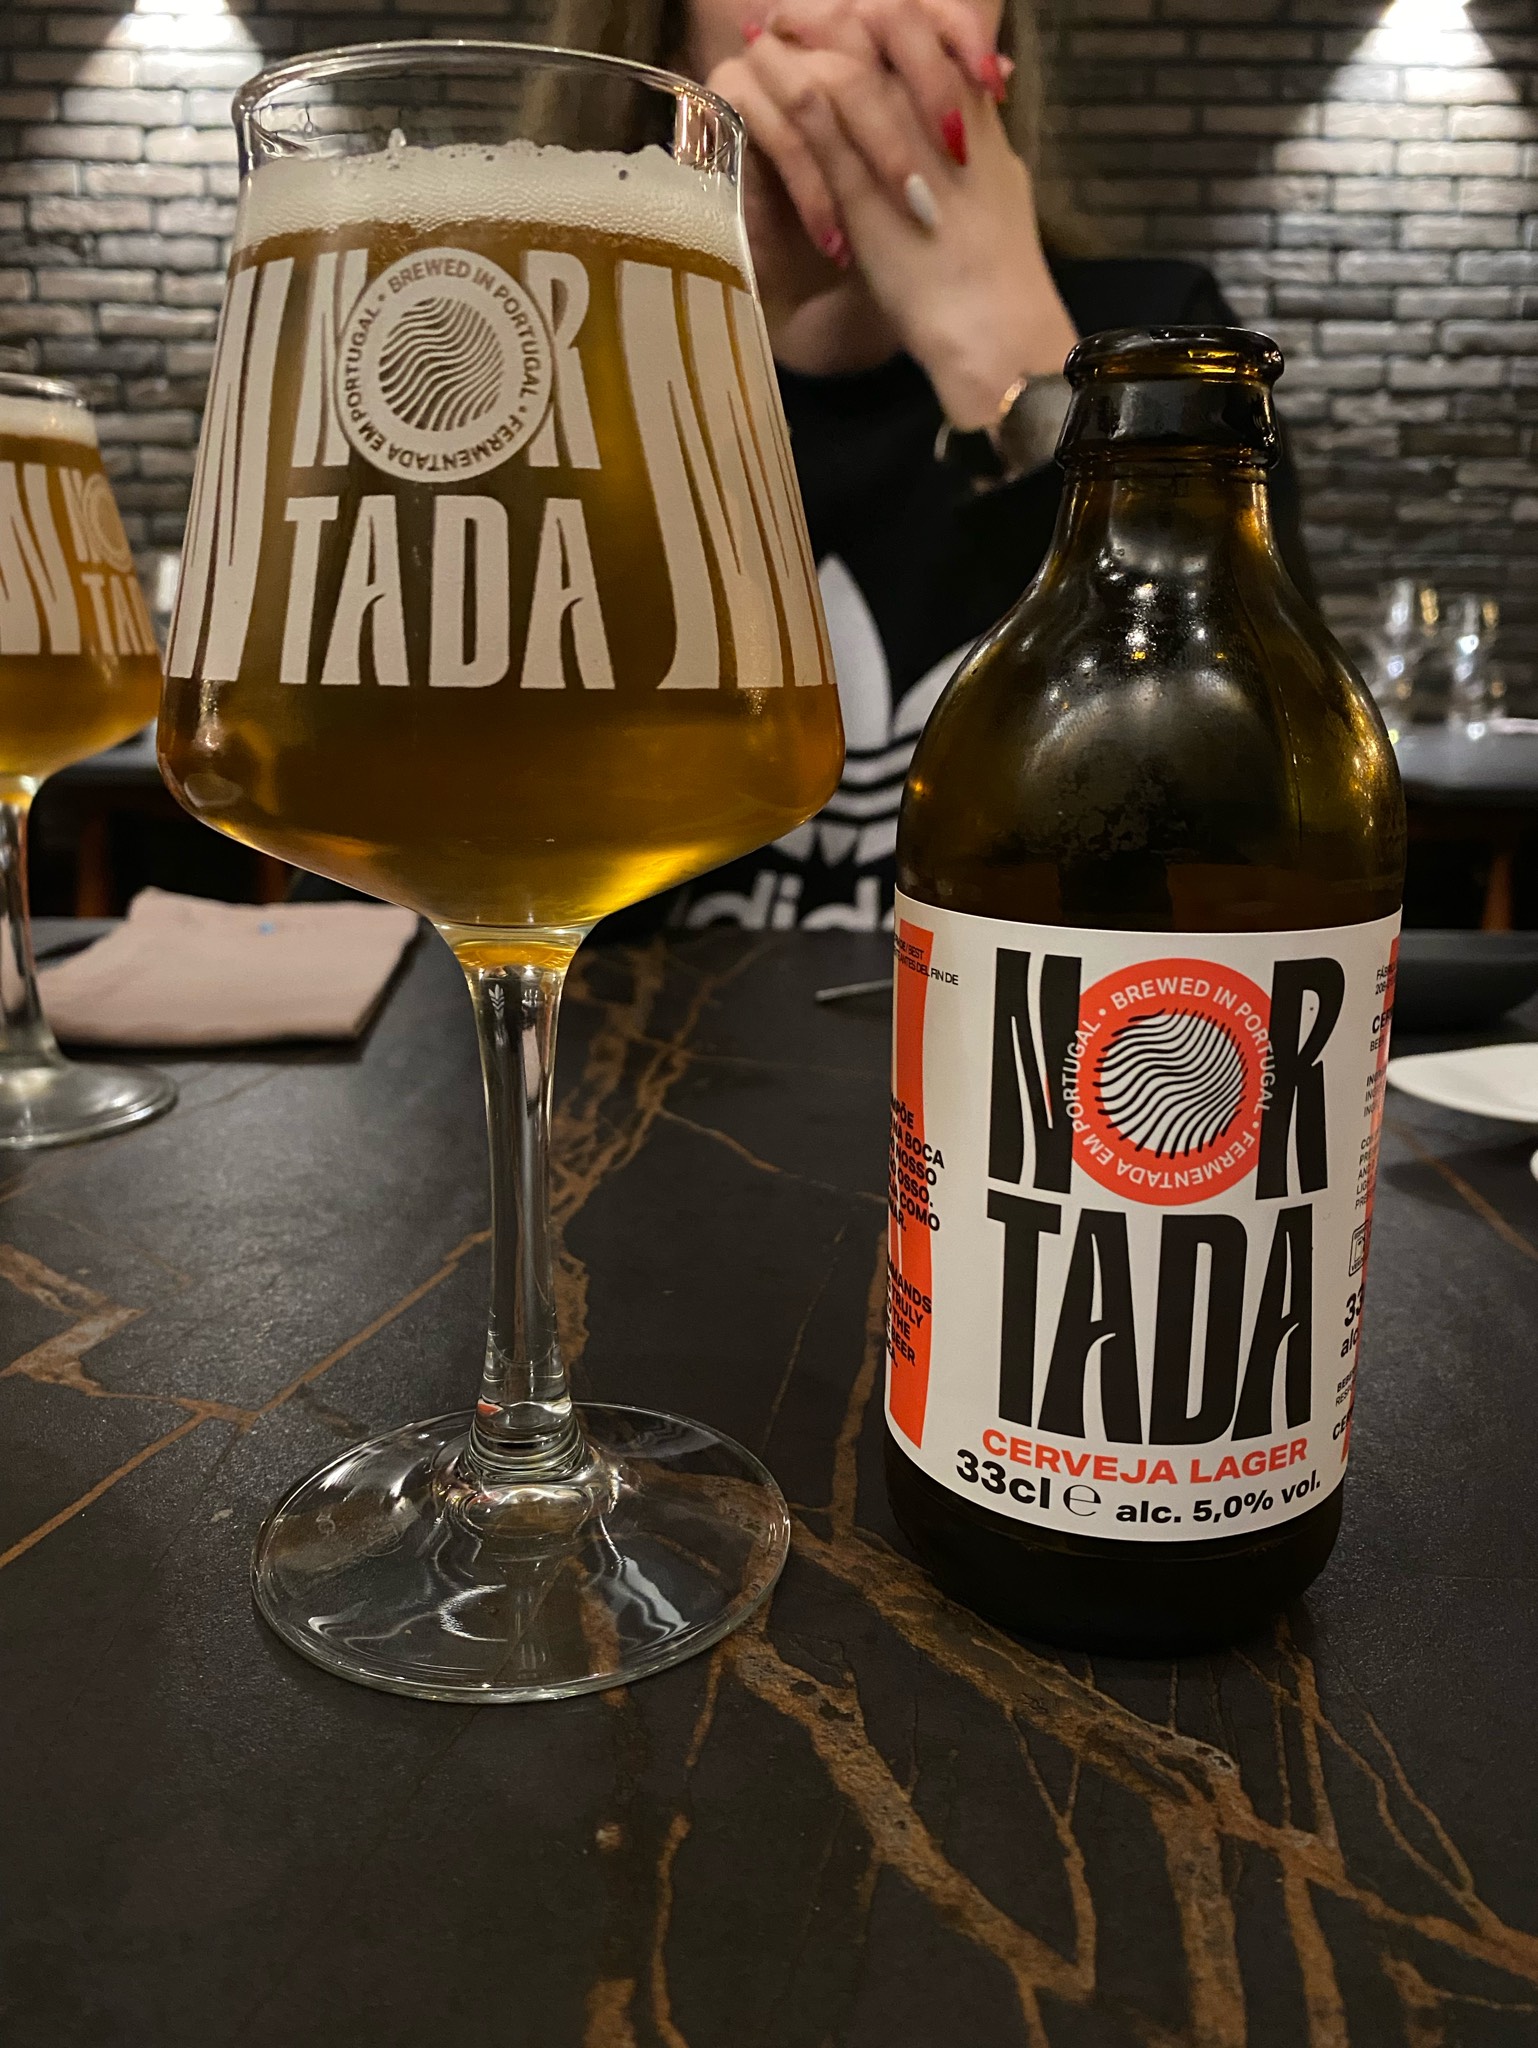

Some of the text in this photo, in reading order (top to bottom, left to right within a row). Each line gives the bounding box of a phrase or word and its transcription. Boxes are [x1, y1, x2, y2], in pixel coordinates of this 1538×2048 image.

[387, 257, 541, 400] BREWED IN PORTUGAL
[345, 306, 524, 474] FERMENTADA EM PORTUGAL
[279, 493, 616, 690] TADA
[945, 972, 959, 986] DE
[1110, 976, 1276, 1115] BREWED IN PORTUGAL
[1061, 1018, 1256, 1189] FERMENTADA EM PORTUGAL
[896, 1146, 937, 1186] NOSSO
[905, 1133, 945, 1169] BOCA
[900, 1192, 940, 1231] COMO
[892, 1283, 924, 1329] TRULY
[893, 1306, 911, 1341] THE
[987, 1189, 1313, 1446] TADA
[892, 1323, 916, 1367] BEER
[981, 1428, 1309, 1485] CERVEJA LAGER
[955, 1448, 1052, 1510] 33cl
[1115, 1500, 1182, 1524] alc.
[1192, 1488, 1274, 1524] 5,0%
[1280, 1468, 1322, 1504] vol.
